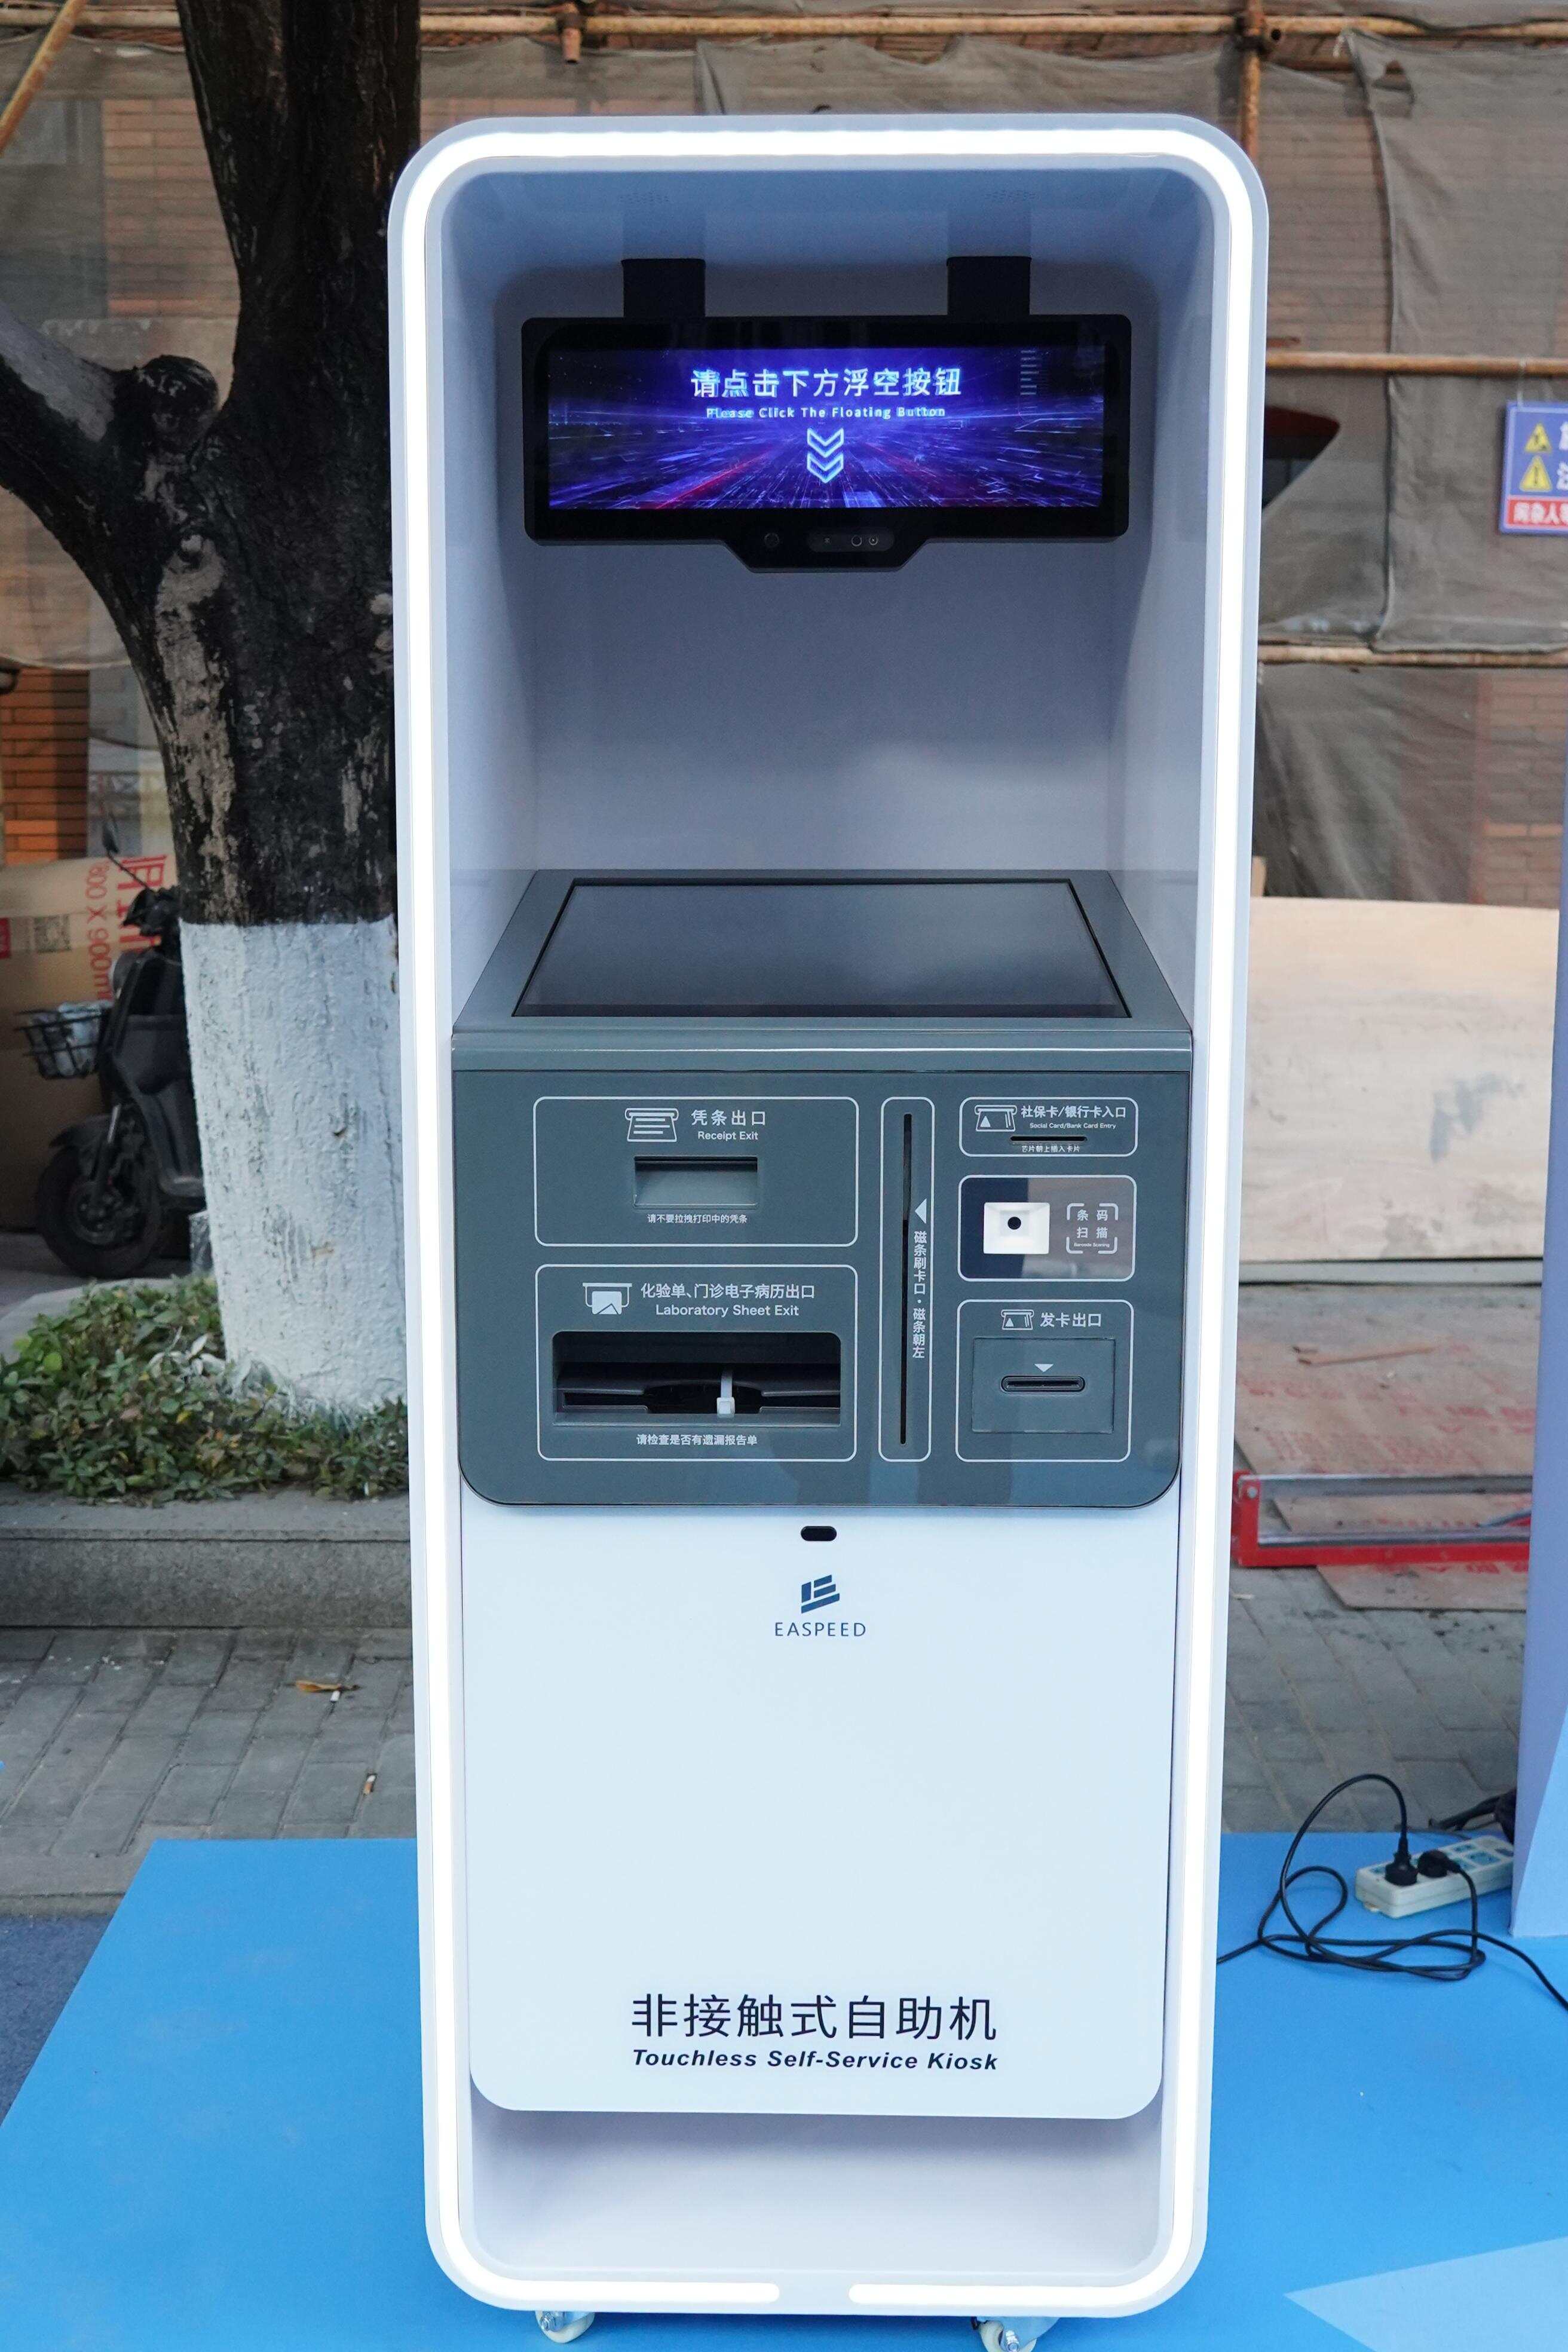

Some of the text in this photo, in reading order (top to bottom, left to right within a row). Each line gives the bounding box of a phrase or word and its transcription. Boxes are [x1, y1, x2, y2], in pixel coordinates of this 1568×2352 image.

[691, 367, 961, 398] 请点击下方浮空按钮
[706, 406, 946, 421] Please Click The Floating Button
[691, 1109, 766, 1126] 凭条出口
[1021, 1105, 1126, 1119] 社保卡/银行卡入口
[697, 1131, 759, 1141] Receipt Exit
[647, 1214, 748, 1224] 请不要拉拽打印中的凭条
[1077, 1209, 1108, 1221] 条码
[1076, 1226, 1108, 1239] 扫描
[641, 1282, 814, 1299] 化验单、门诊电子病历出口
[656, 1304, 800, 1318] Laboratory Sheet Exit
[1040, 1312, 1102, 1328] 发卡出口
[636, 1434, 758, 1446] 请检查是否有遗漏报告单
[775, 1622, 866, 1637] EASPEED
[632, 1993, 997, 2041] 非接触式自助机
[633, 2049, 998, 2071] Touchless Self-Service Kiosk
